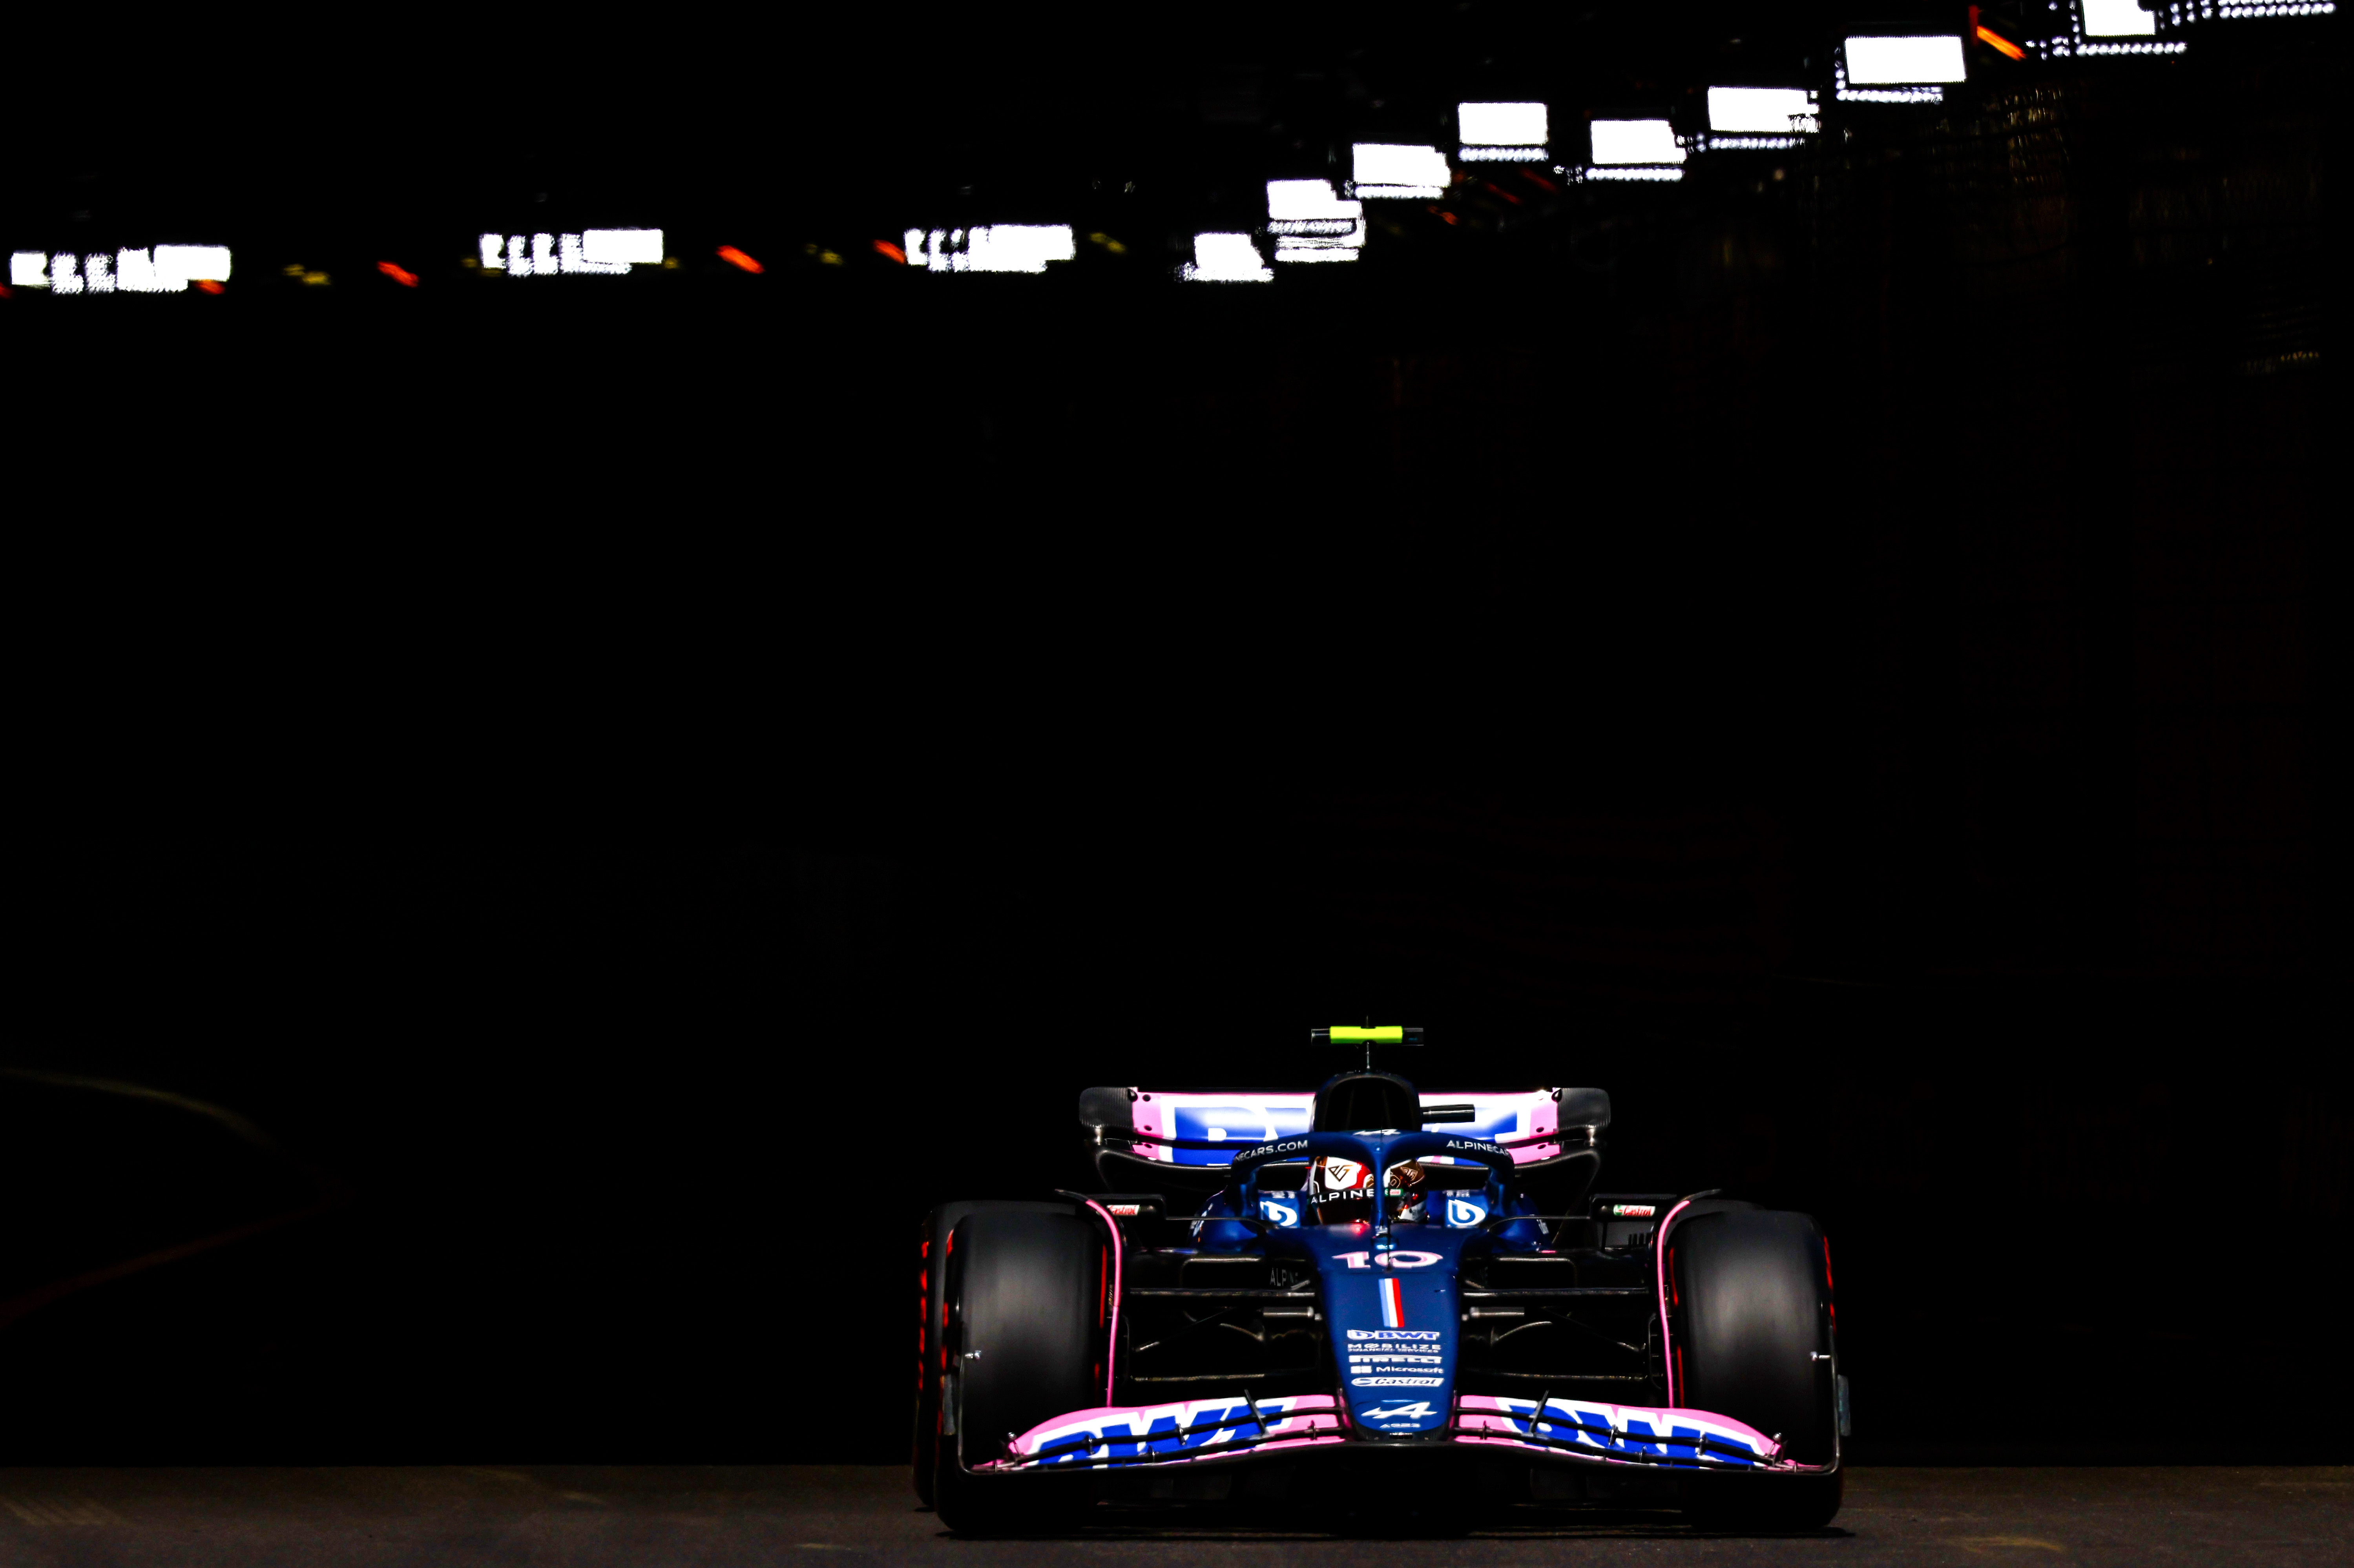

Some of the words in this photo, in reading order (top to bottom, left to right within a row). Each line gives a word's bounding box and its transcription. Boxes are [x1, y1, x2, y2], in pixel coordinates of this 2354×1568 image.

[1311, 1189, 1374, 1204] ALPINE
[1332, 1250, 1443, 1269] 10
[1376, 1331, 1439, 1340] BWT
[1349, 1355, 1442, 1364] PIRELLI
